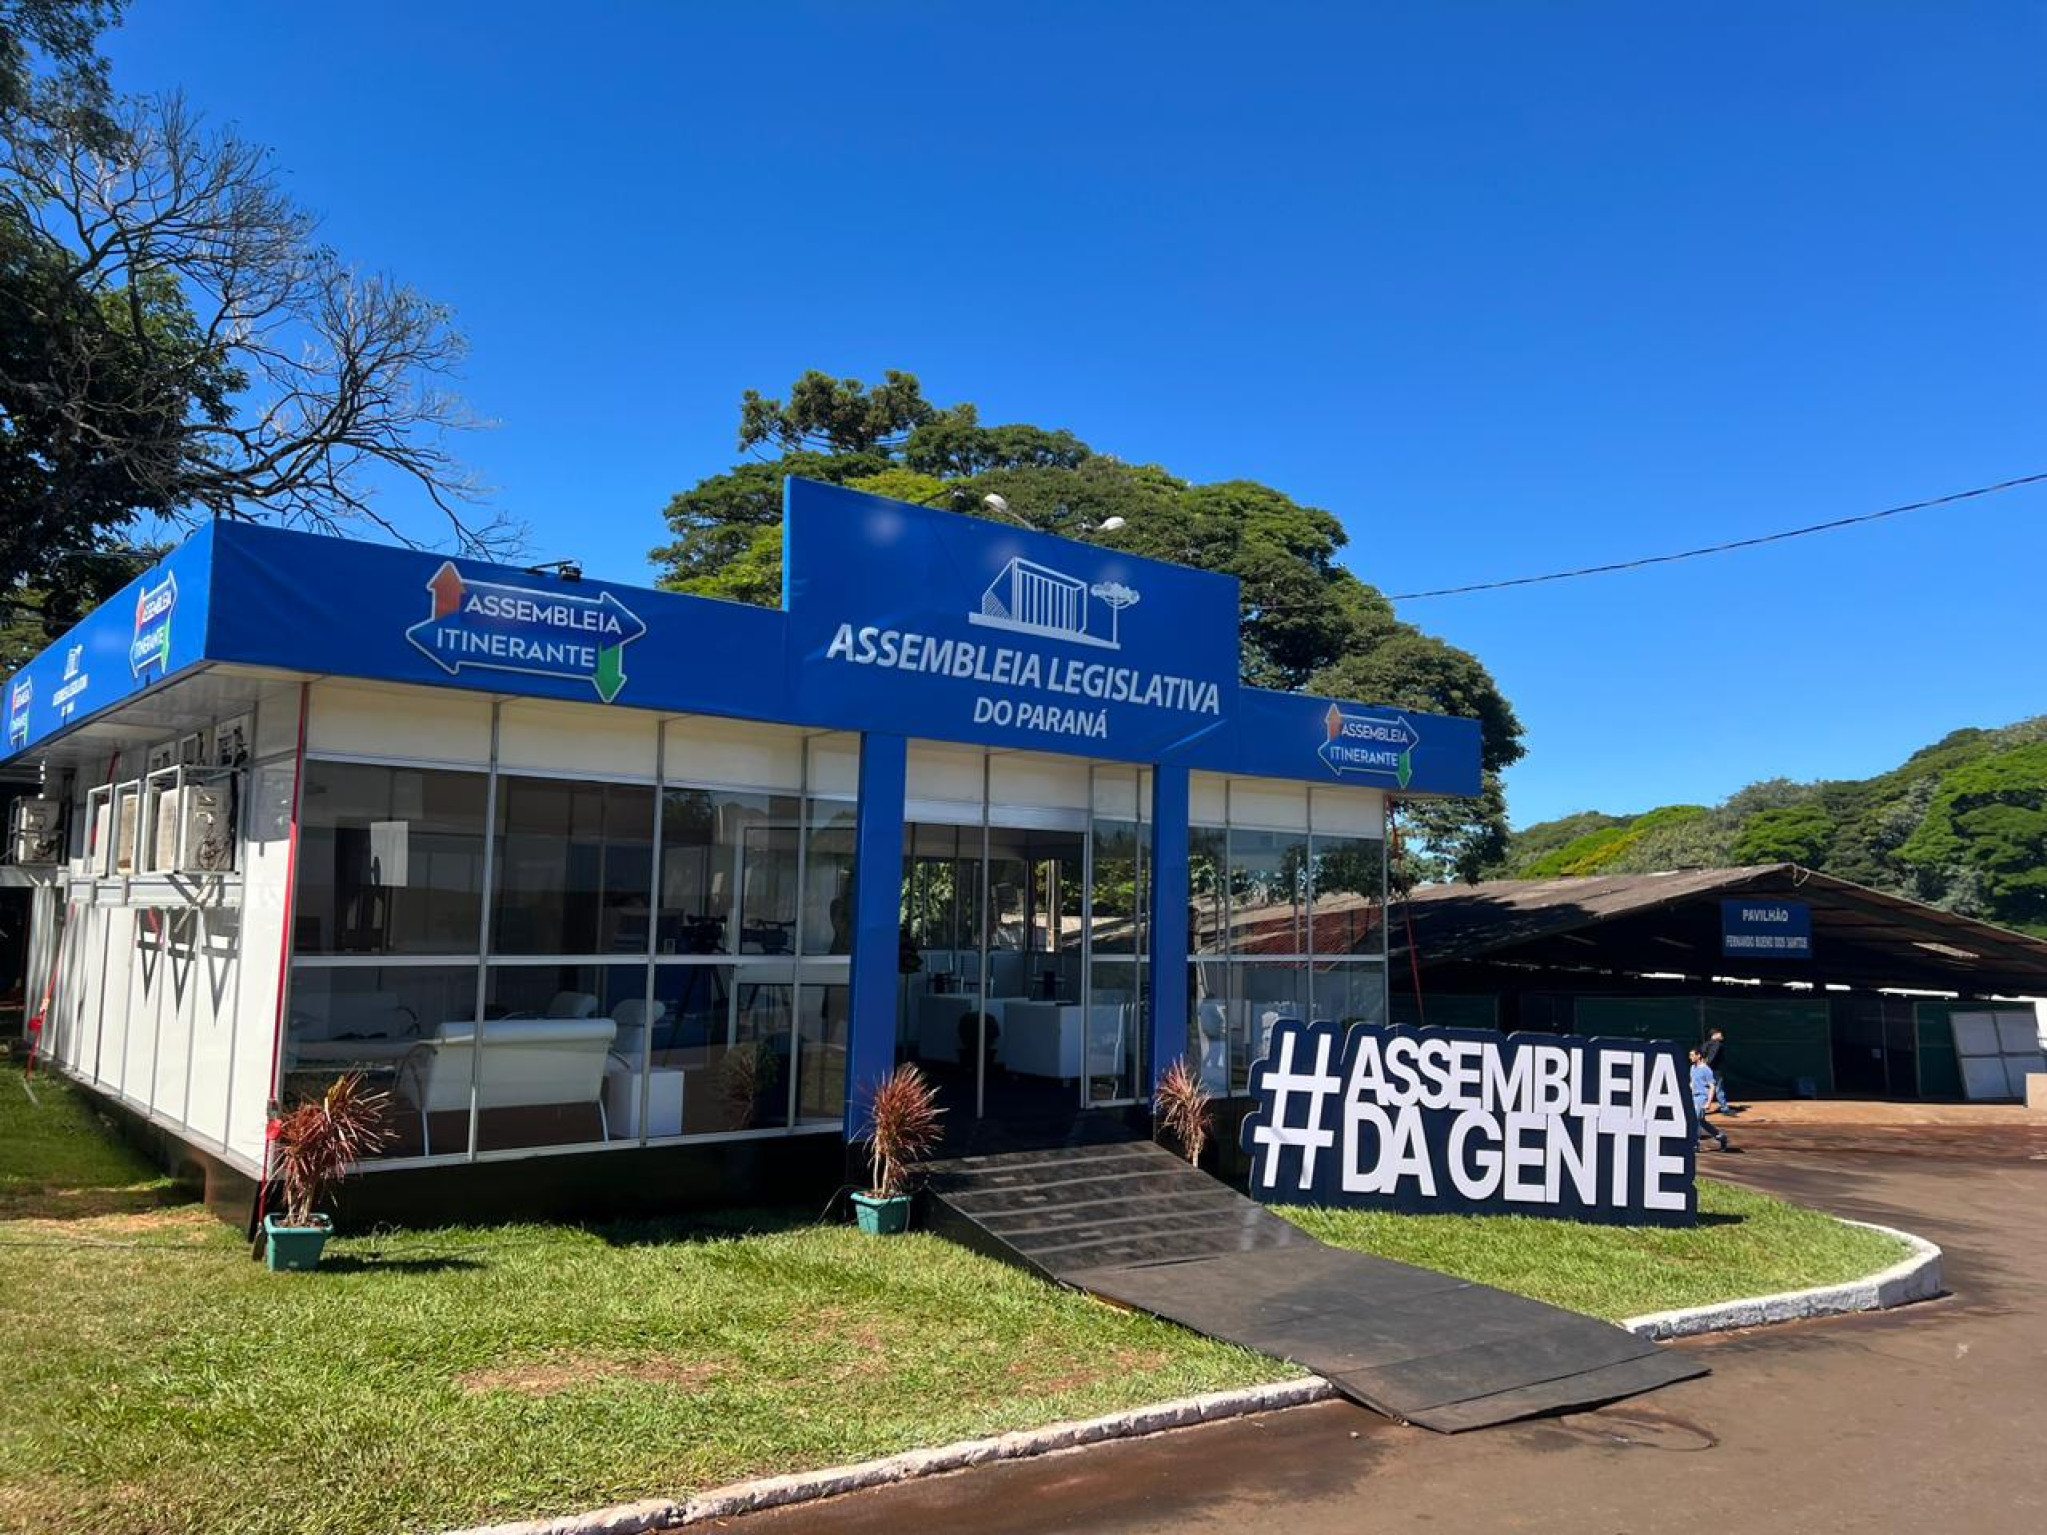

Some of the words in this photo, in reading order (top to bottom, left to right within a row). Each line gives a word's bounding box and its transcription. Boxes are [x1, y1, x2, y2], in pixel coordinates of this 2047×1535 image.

[464, 594, 623, 635] ASSEMBLEIA
[437, 627, 596, 668] ITINERANTE
[827, 623, 1041, 690] ASSEMBLEIA
[1047, 656, 1221, 715] LEGISLATIVA
[973, 697, 1012, 727] DO
[1015, 702, 1108, 739] PARANÁ
[1341, 723, 1409, 743] ASSEMBLEIA
[1330, 746, 1399, 767] ITINERANTE
[1342, 1102, 1437, 1197] DA
[1448, 1109, 1687, 1210] GENTE
